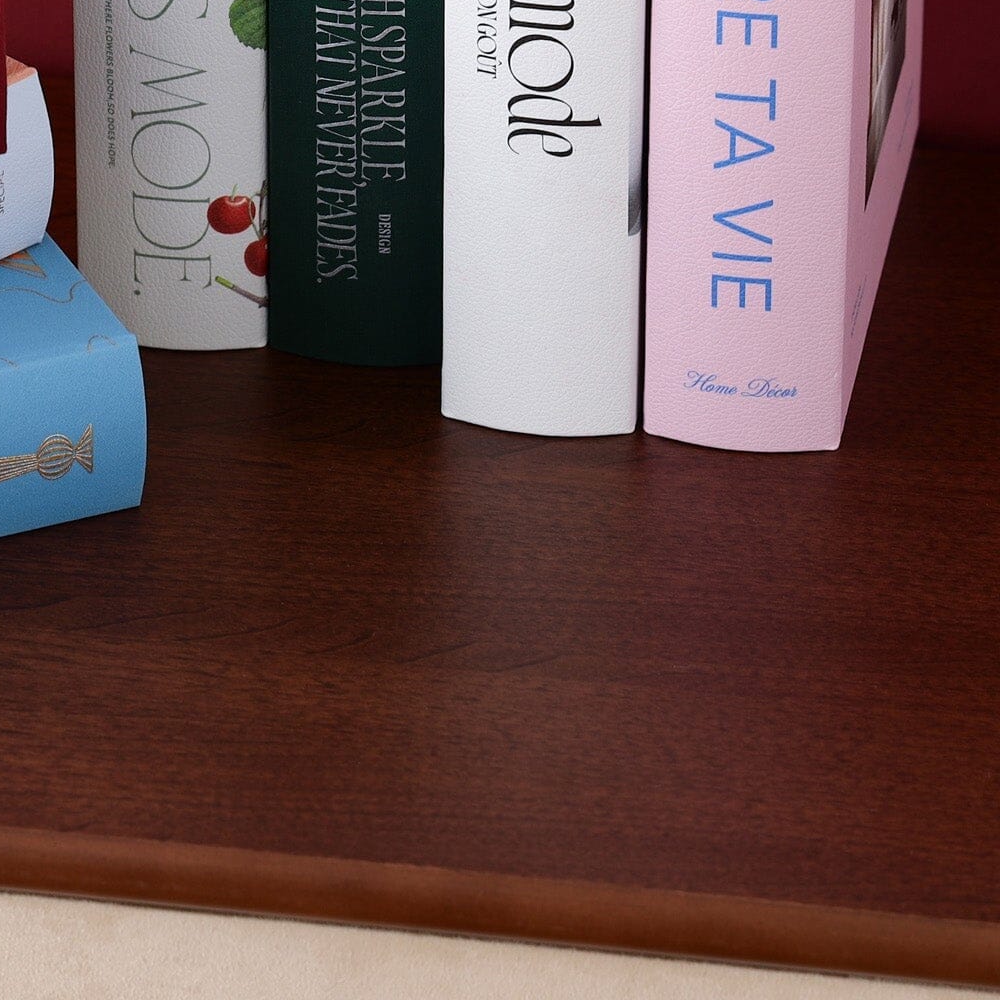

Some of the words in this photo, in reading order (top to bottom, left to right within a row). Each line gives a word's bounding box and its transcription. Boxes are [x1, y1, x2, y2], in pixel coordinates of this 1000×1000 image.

[105, 25, 115, 67] FLOWERS
[107, 117, 116, 141] DOES
[713, 79, 777, 169] TA
[128, 44, 213, 297] MODE.
[315, 184, 359, 284] FADES.
[378, 213, 392, 255] DESIGN
[711, 200, 774, 312] VIE
[683, 370, 738, 396] Home
[740, 376, 799, 399] Décor
